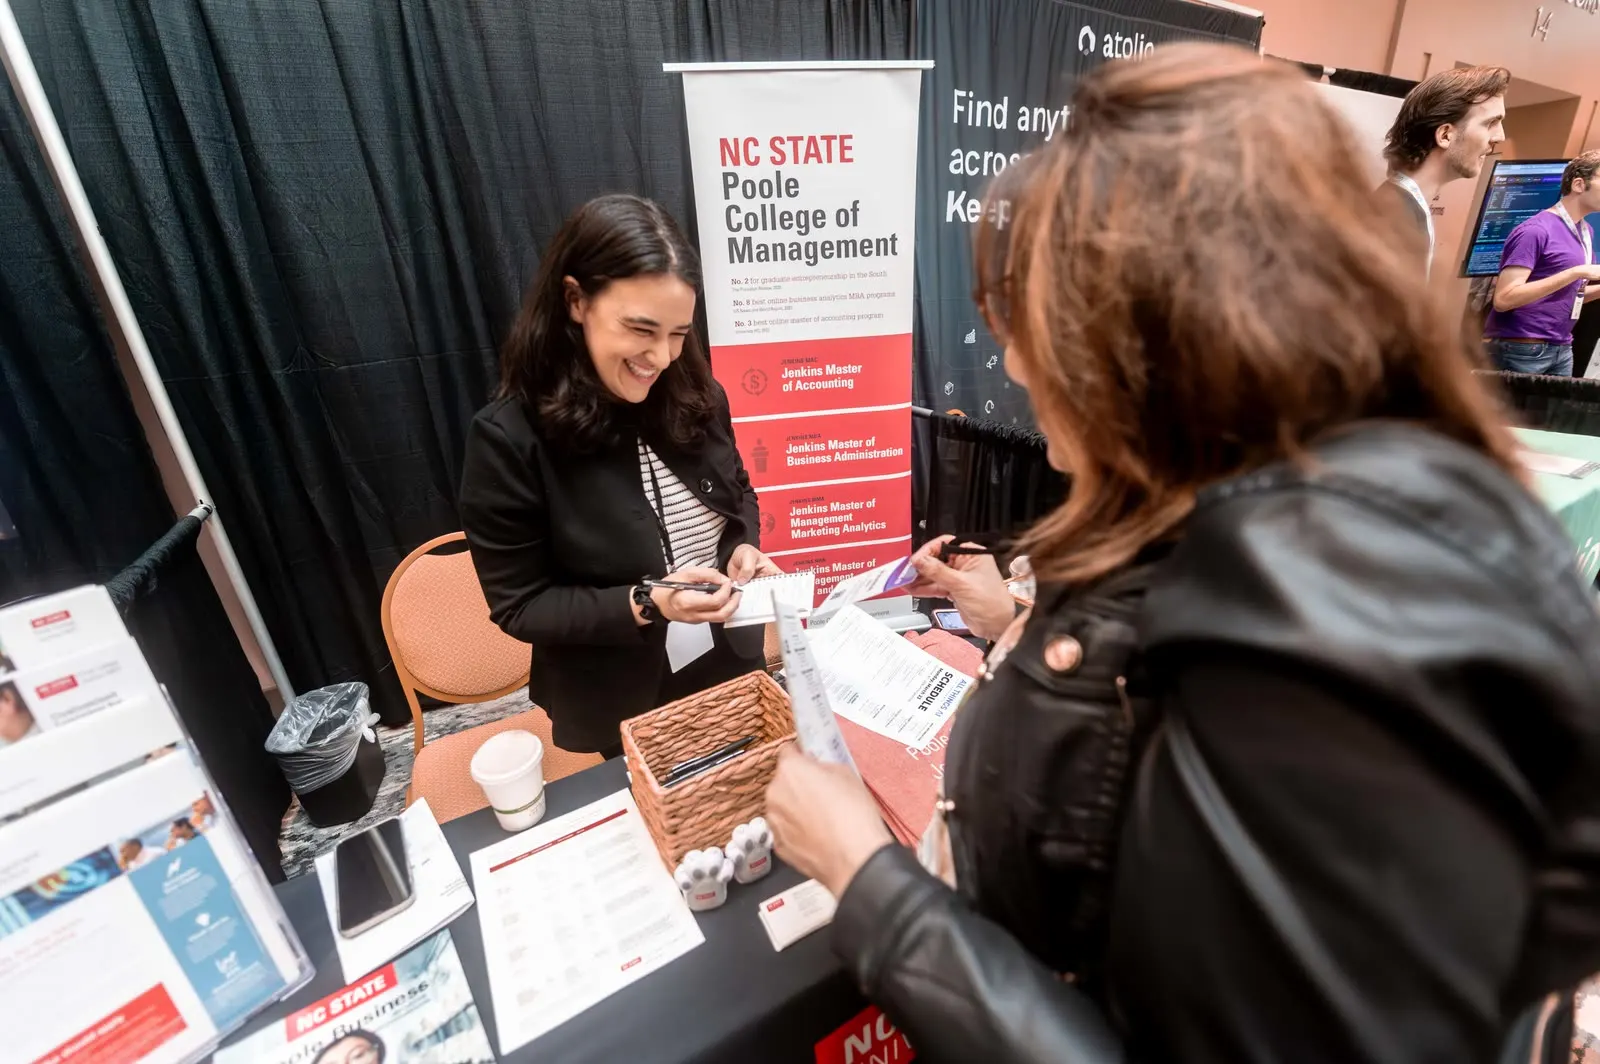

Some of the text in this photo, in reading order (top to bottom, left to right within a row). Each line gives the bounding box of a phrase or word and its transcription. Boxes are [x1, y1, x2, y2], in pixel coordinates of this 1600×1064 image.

[1531, 5, 1554, 42] 14
[953, 88, 1074, 141] Find anyt
[719, 134, 854, 167] NC STATE
[949, 148, 1031, 177] acro
[722, 170, 800, 200] Poole
[725, 200, 860, 236] College of
[727, 233, 898, 267] Management
[761, 276, 790, 285] graduate
[819, 294, 848, 302] analytics
[848, 292, 865, 300] MBA
[747, 319, 752, 327] 3
[813, 315, 820, 323] of
[820, 314, 856, 322] accounting
[857, 312, 884, 321] program
[781, 363, 862, 379] Jenkins Master
[782, 378, 854, 392] of Accounting
[785, 436, 876, 454] Jenkins Master of
[786, 447, 904, 467] Business Administration
[789, 503, 828, 517] Jenkins
[830, 499, 864, 512] Master
[866, 498, 876, 509] of
[790, 513, 853, 528] Management
[791, 520, 887, 540] Marketing Analytics
[796, 565, 830, 575] kins
[832, 561, 865, 572] Master
[867, 558, 876, 568] of
[815, 573, 854, 586] agement
[817, 585, 834, 595] and
[930, 668, 944, 683] Monday,
[956, 679, 967, 689] ALL
[918, 671, 954, 712] SCHEDULE
[920, 683, 932, 695] March
[941, 689, 961, 710] THINGS
[296, 1006, 327, 1032] NC
[329, 974, 387, 1015] STATE
[333, 981, 429, 1040] Business
